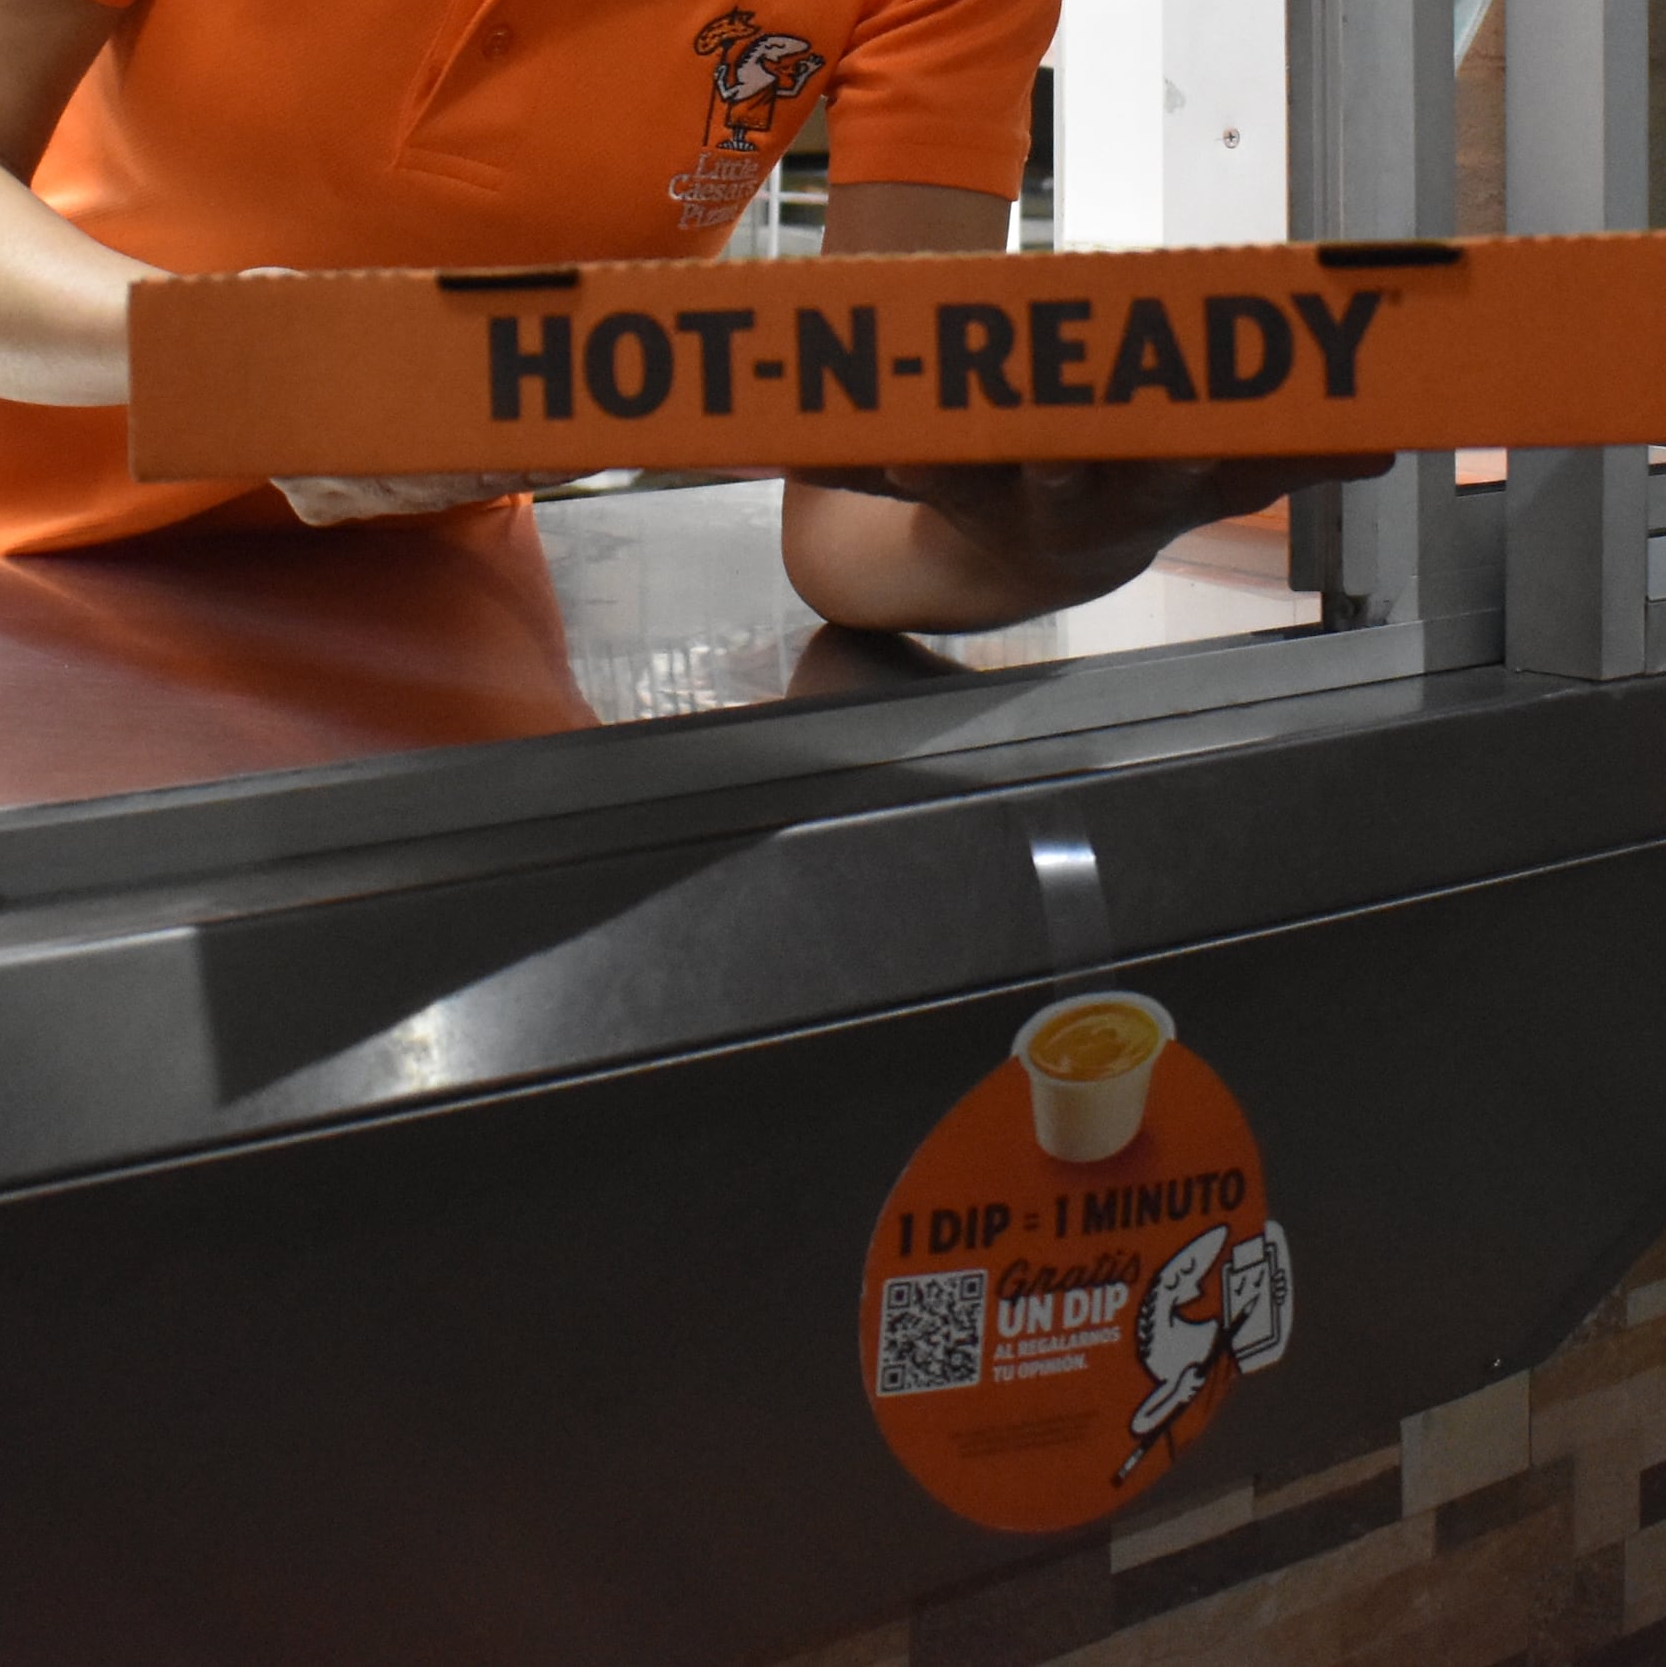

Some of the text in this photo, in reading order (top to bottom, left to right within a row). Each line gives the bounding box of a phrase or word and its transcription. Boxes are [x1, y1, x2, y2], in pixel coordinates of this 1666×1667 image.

[487, 290, 1385, 422] HOT-N-READY
[928, 1203, 1011, 1254] DIP
[1083, 1167, 1245, 1235] MINUTO
[998, 1282, 1129, 1338] UN DIP
